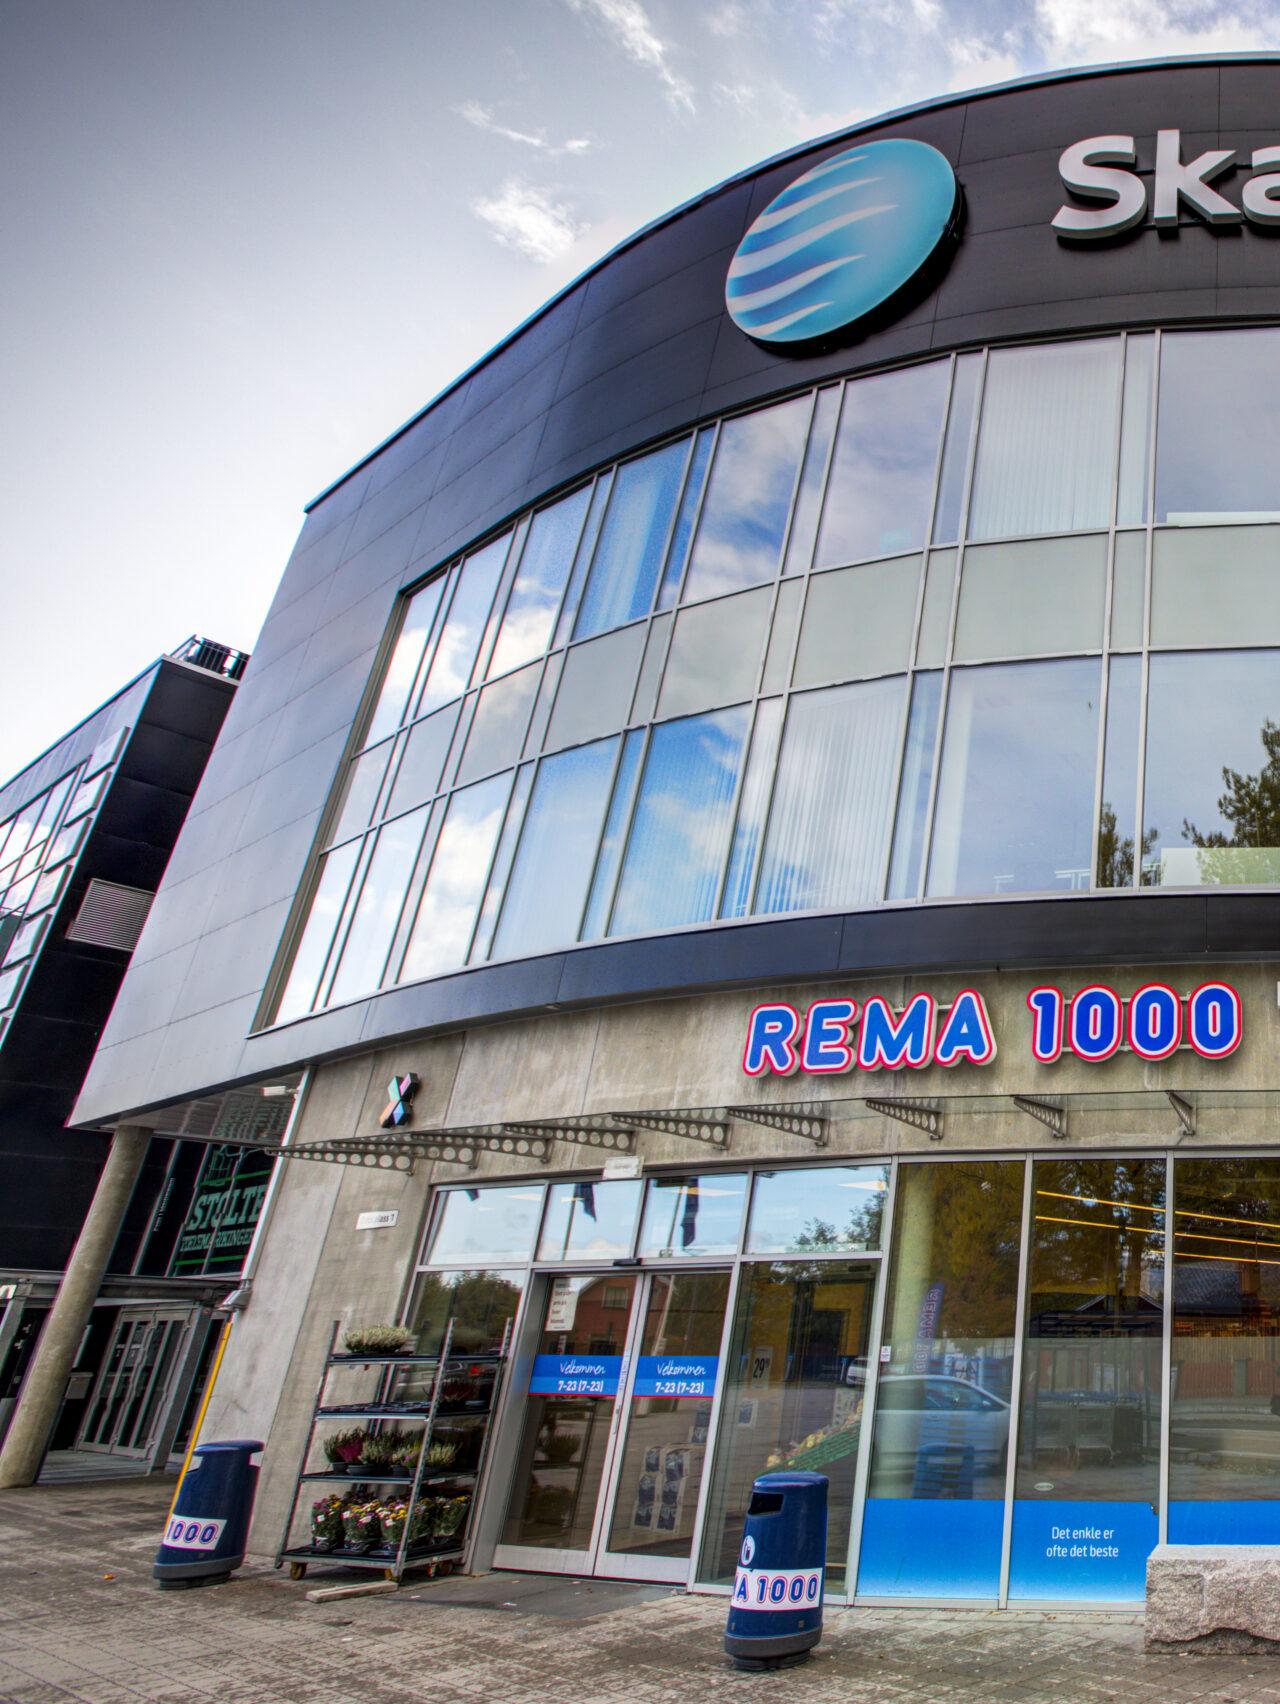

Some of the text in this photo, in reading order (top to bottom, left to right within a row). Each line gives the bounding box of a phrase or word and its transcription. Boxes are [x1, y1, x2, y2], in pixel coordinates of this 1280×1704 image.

[742, 988, 998, 1078] REMA
[1027, 980, 1244, 1064] 1000
[560, 1360, 607, 1375] Velkommen
[657, 1360, 707, 1376] Velkommen
[558, 1380, 604, 1393] 7-23 (7-23)
[655, 1382, 704, 1394] 7-23 (7-23)
[167, 1520, 219, 1543] 1000
[1051, 1526, 1114, 1539] Det enkle er
[1046, 1544, 1119, 1557] ofte det beste
[756, 1573, 819, 1603] 1000
